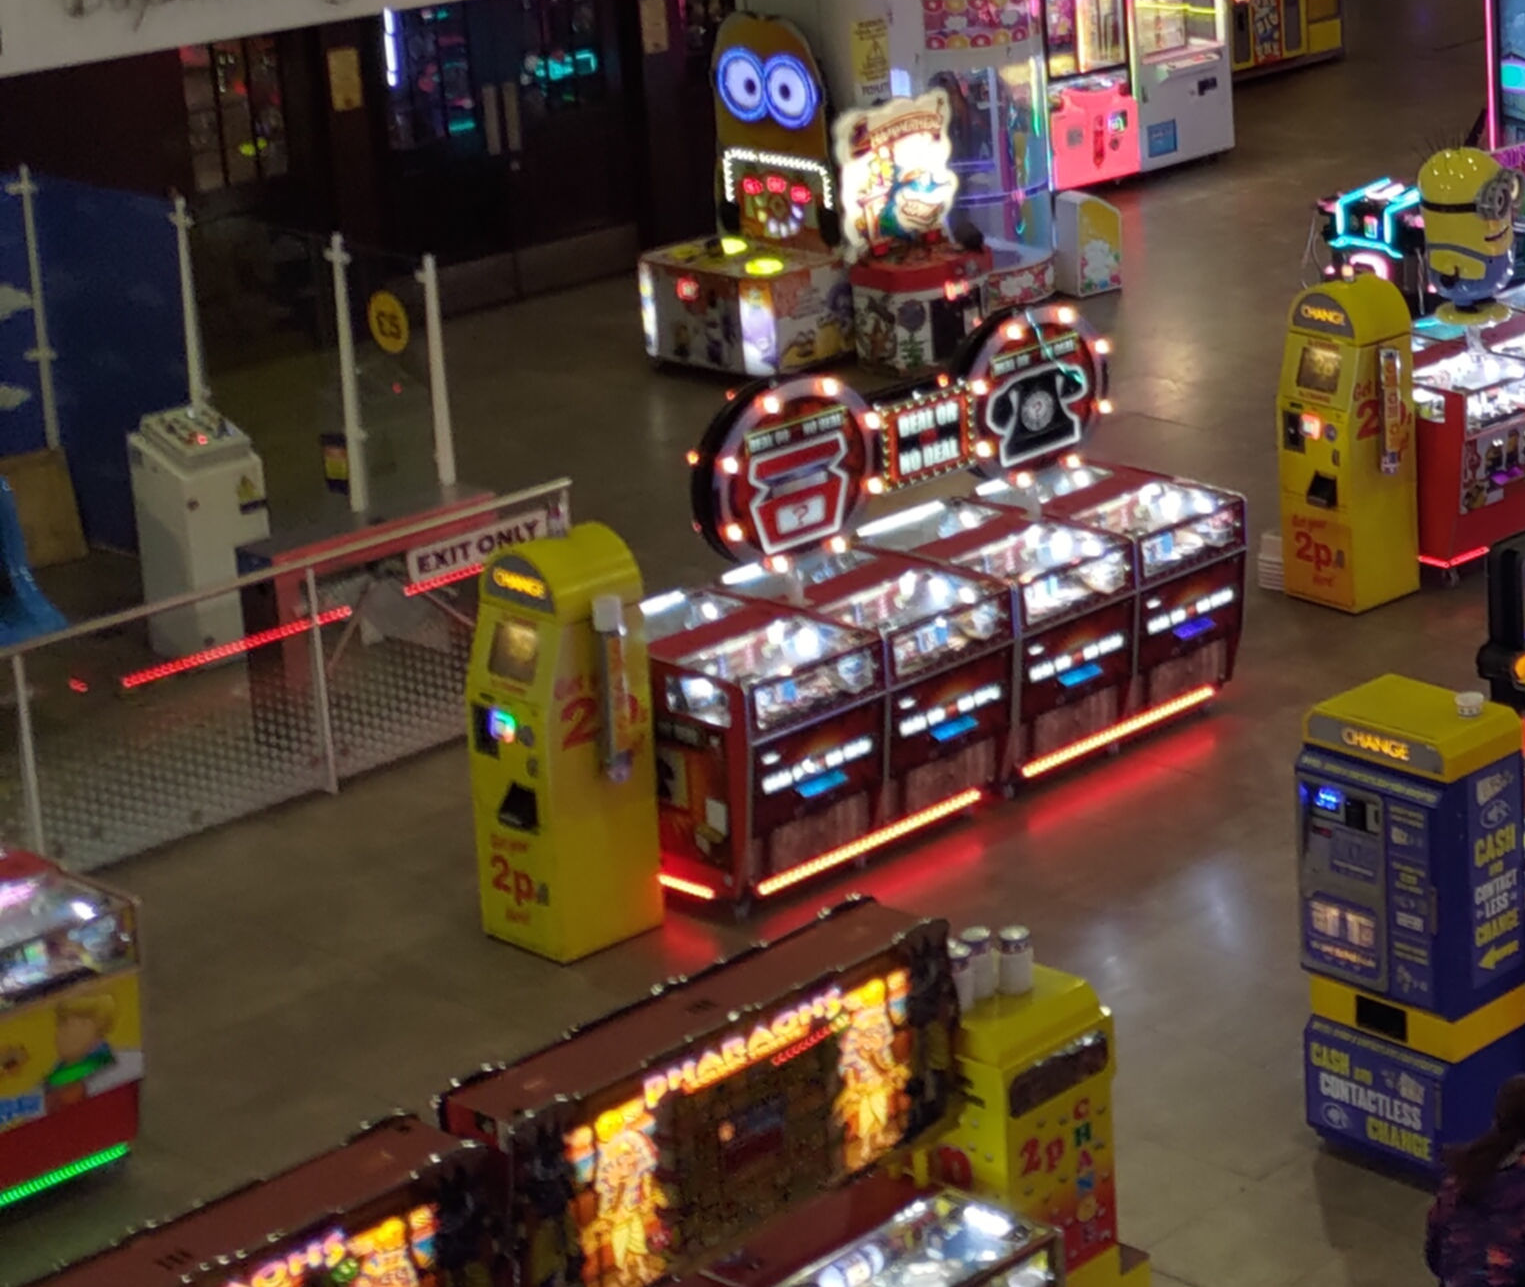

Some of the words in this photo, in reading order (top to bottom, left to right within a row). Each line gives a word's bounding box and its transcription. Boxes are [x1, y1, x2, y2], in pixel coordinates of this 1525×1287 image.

[1301, 304, 1346, 326] CHANGE
[899, 407, 936, 436] DEAL
[937, 401, 959, 426] OR
[899, 451, 921, 475] NO
[922, 438, 960, 469] DEAL
[417, 542, 474, 575] EXIT
[478, 520, 542, 555] ONLY
[1294, 531, 1332, 572] 2p
[493, 567, 546, 600] CHANGE
[1341, 726, 1412, 761] CHANGE
[1474, 823, 1517, 868] CASH
[490, 854, 536, 907] 2p
[1474, 868, 1518, 906] CONTACT
[1485, 892, 1512, 919] LESS
[1310, 1041, 1351, 1078] CASH
[1319, 1071, 1423, 1131] CONTACTLESS
[1365, 1114, 1433, 1163] CHANGE
